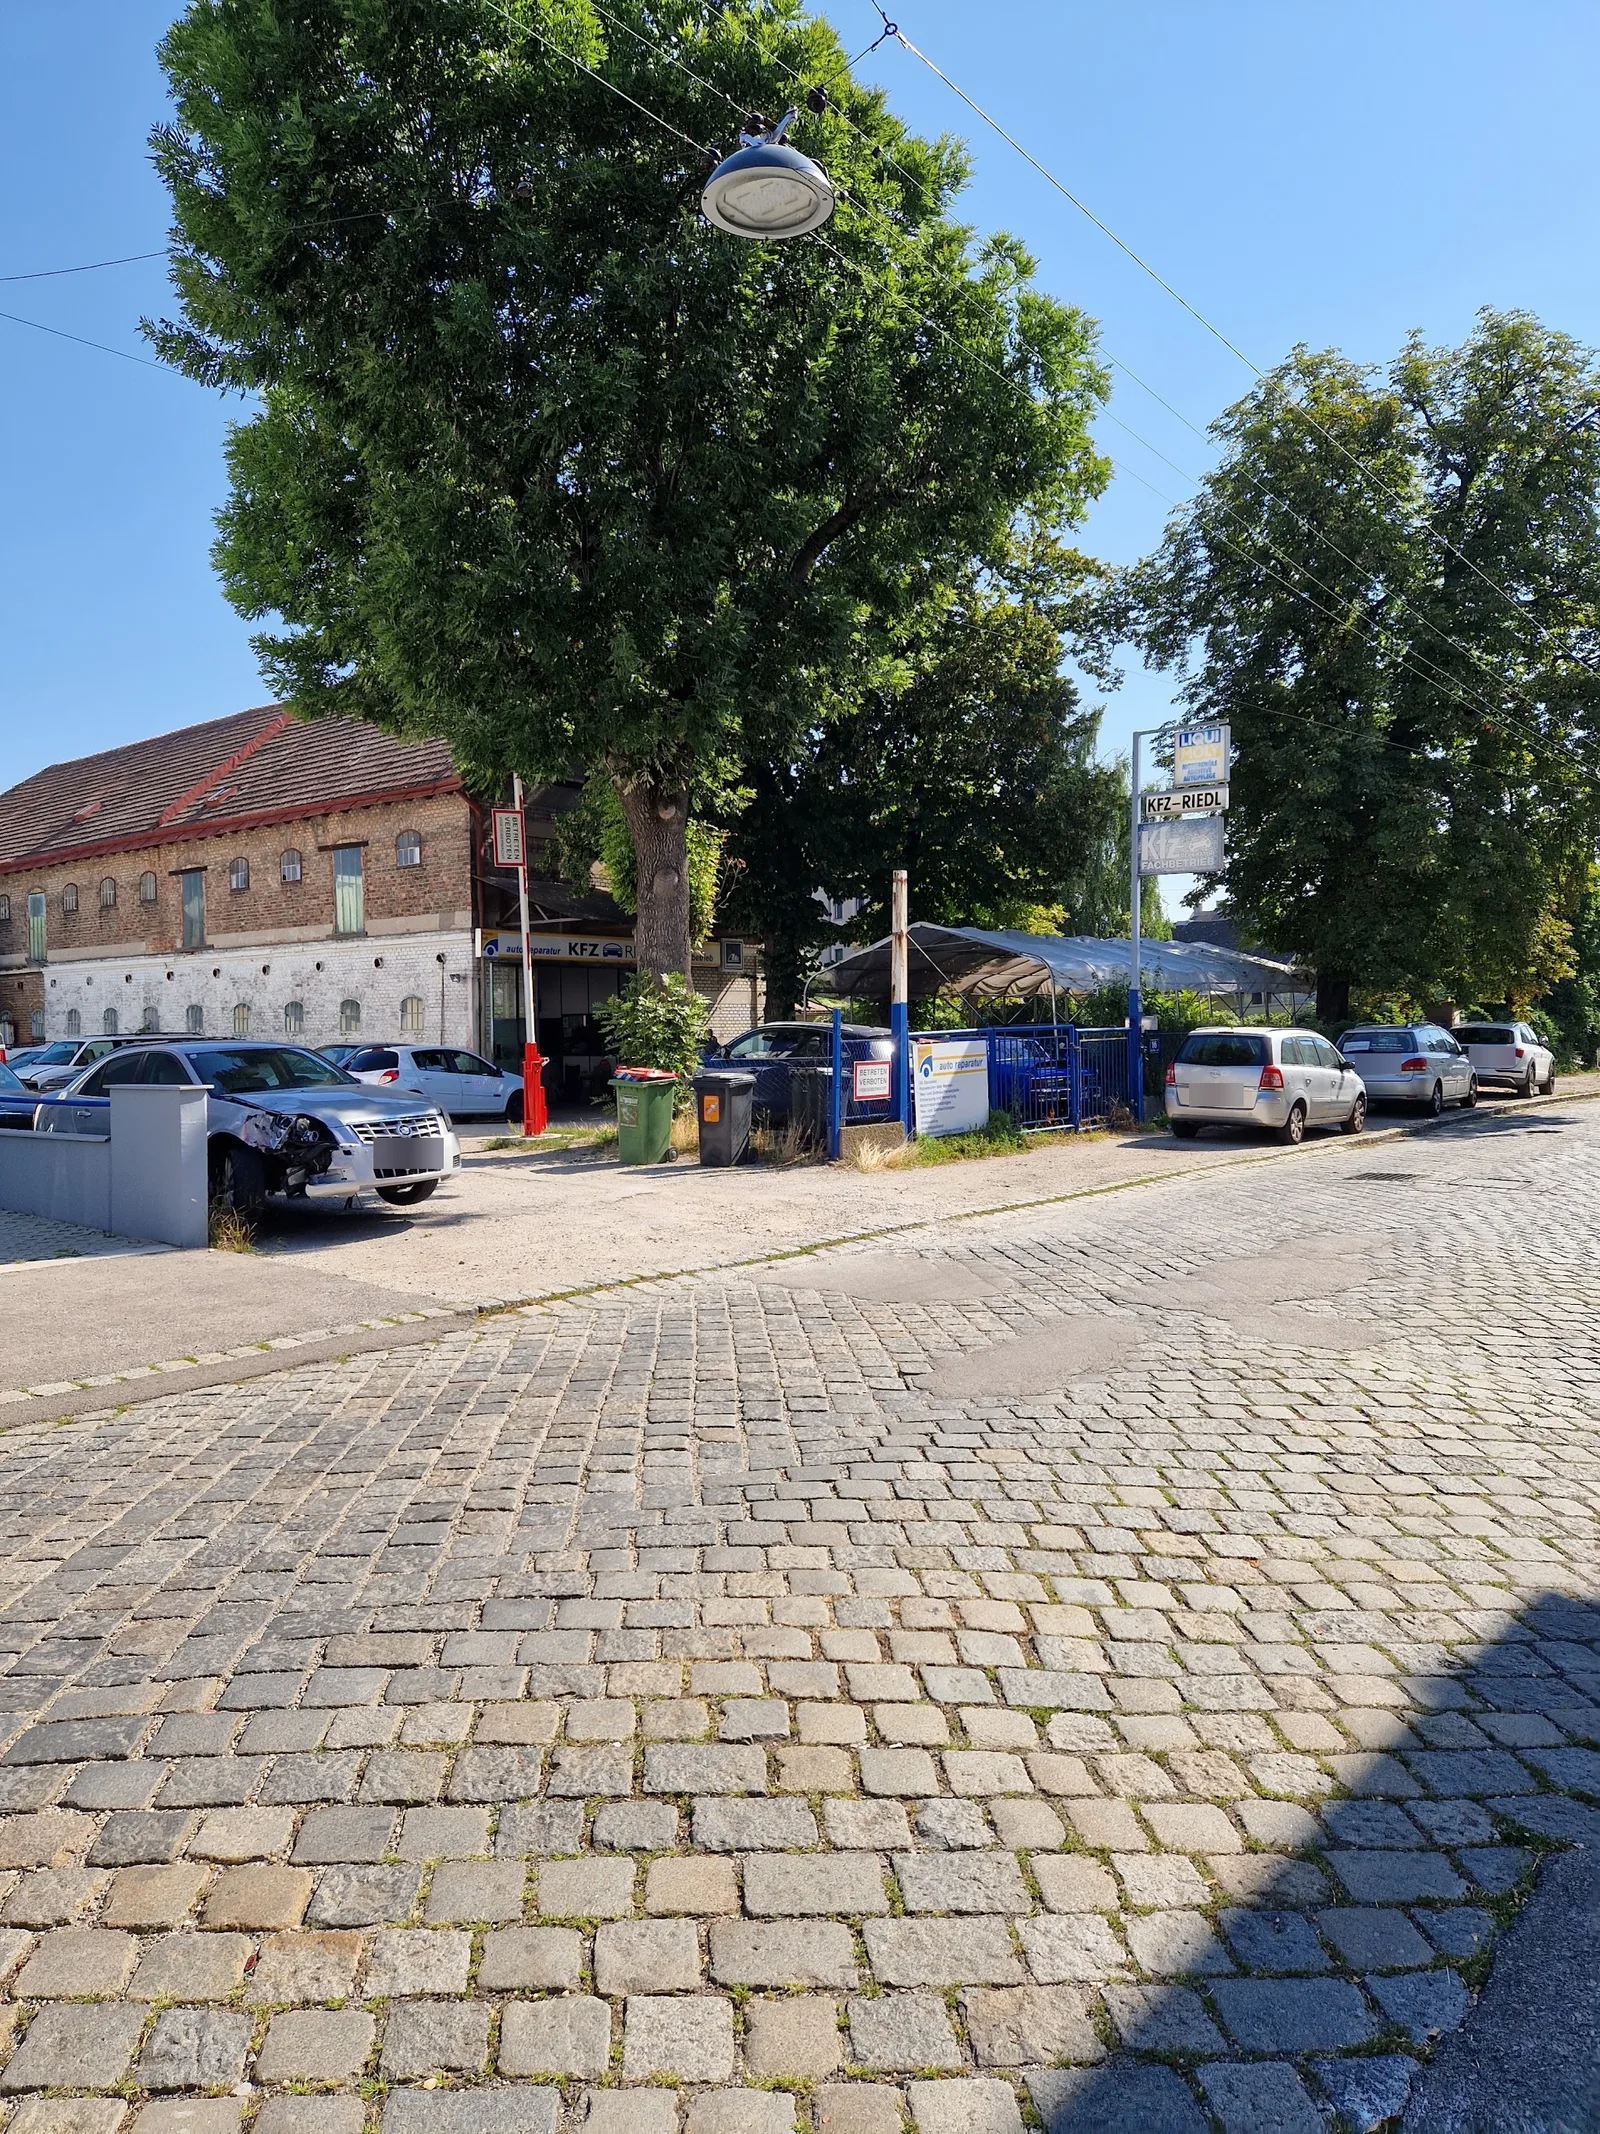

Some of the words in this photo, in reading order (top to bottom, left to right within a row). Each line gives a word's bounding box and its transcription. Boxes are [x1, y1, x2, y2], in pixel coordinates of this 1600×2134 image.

[1180, 730, 1220, 747] LIQUI
[1180, 744, 1221, 761] MOLY
[1141, 857, 1215, 870] FACHBETRIEB
[529, 946, 561, 956] eparatur
[568, 942, 600, 957] KFZ
[939, 1061, 953, 1071] auto
[954, 1059, 983, 1070] reparatur
[859, 1068, 887, 1077] BETRETEN
[859, 1077, 887, 1086] VERBOTEN
